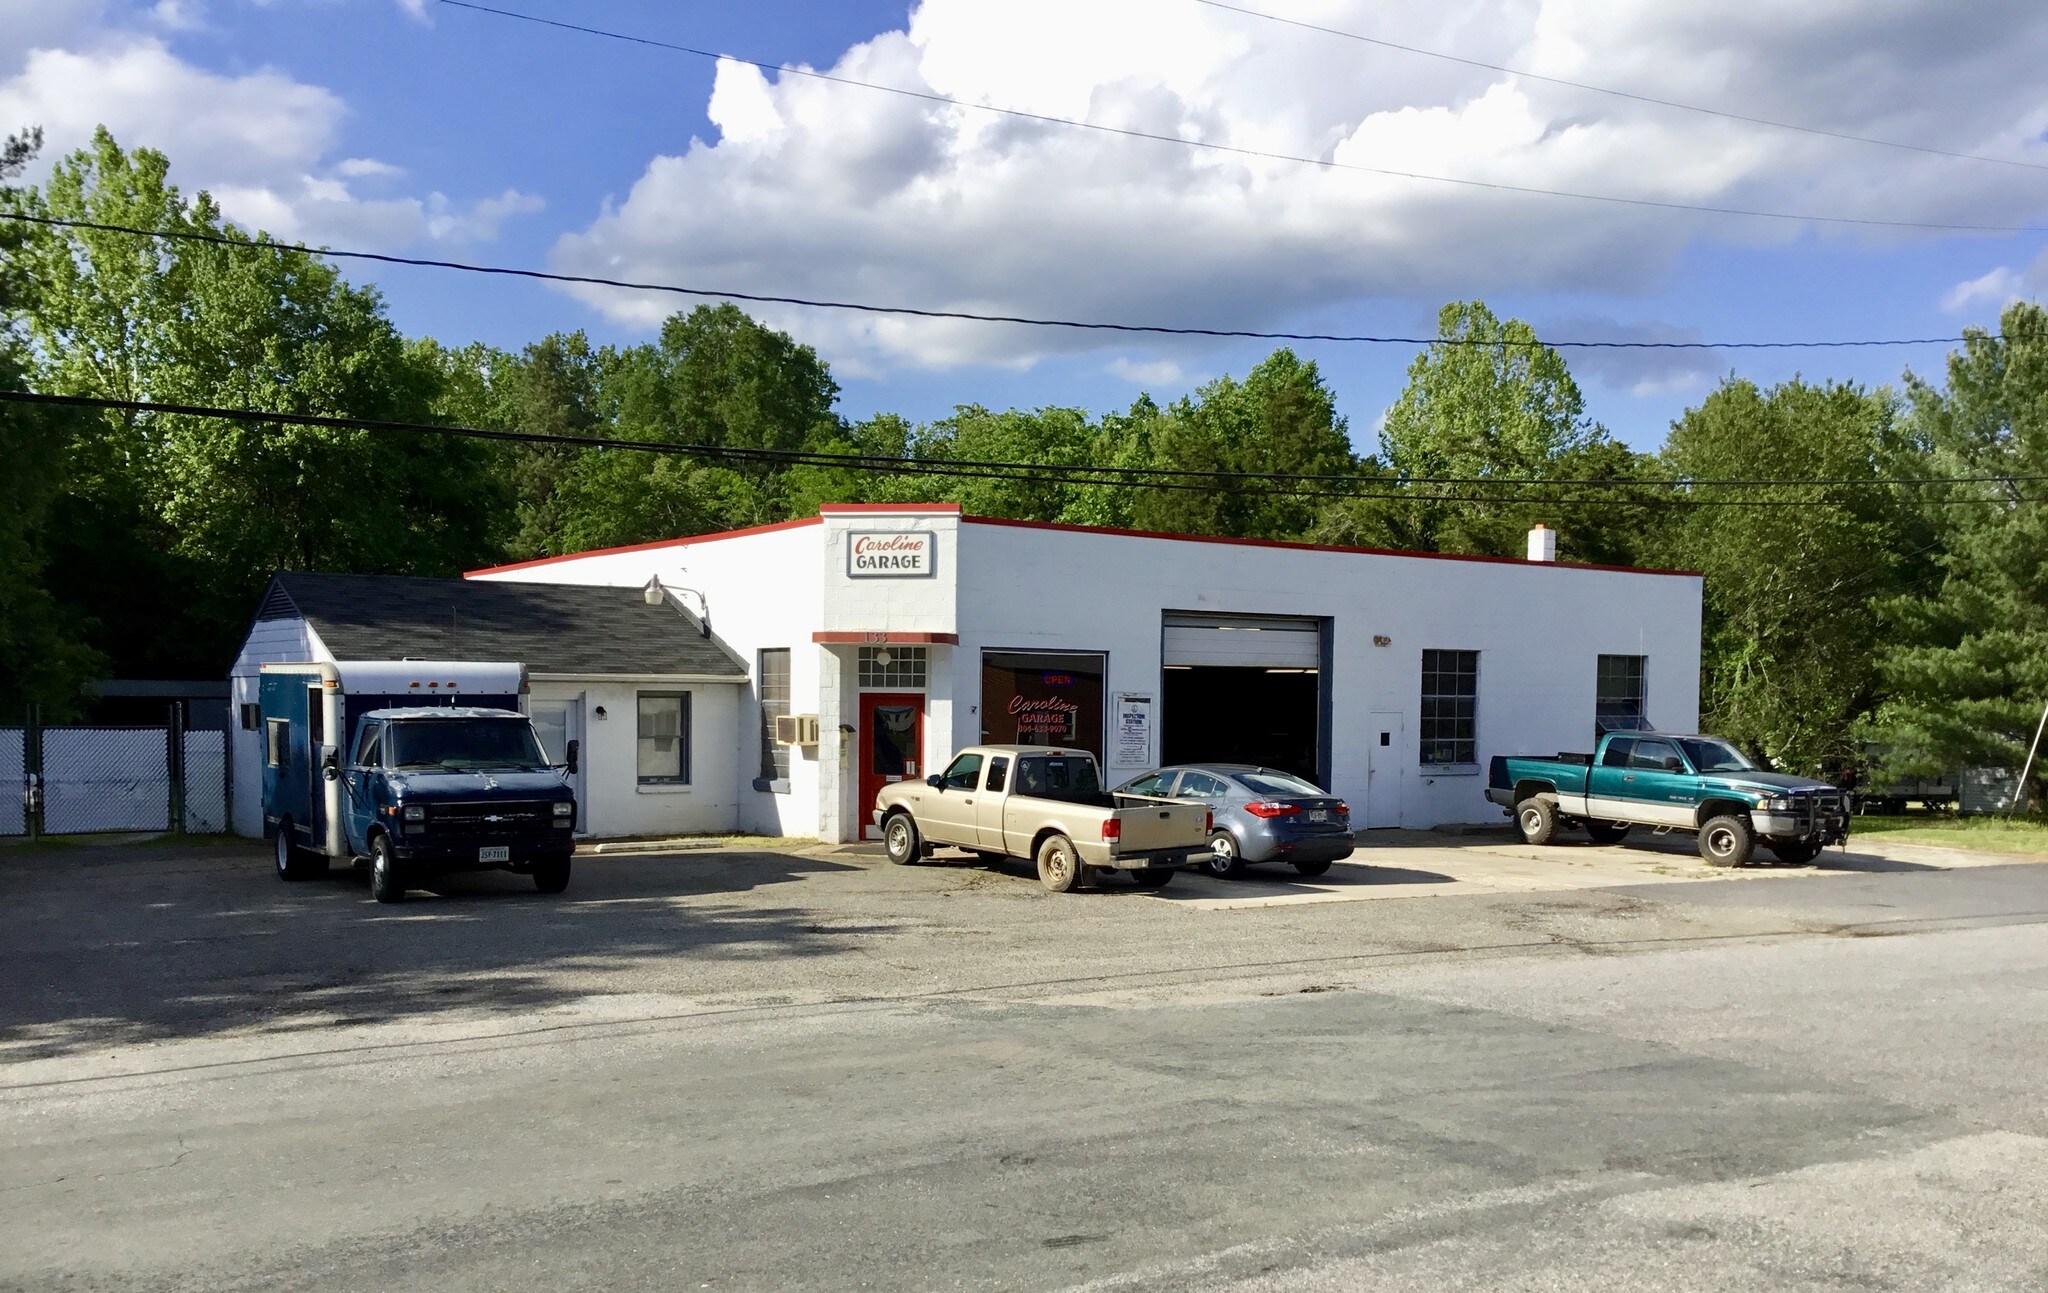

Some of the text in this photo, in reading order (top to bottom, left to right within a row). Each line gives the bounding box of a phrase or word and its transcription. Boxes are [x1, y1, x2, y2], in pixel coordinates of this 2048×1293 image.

[855, 535, 924, 555] Caroline
[856, 555, 921, 569] GARAGE
[864, 632, 888, 643] 133
[1045, 675, 1071, 684] OPEN
[1008, 695, 1079, 715] Caroline
[1021, 713, 1065, 724] GARAGE
